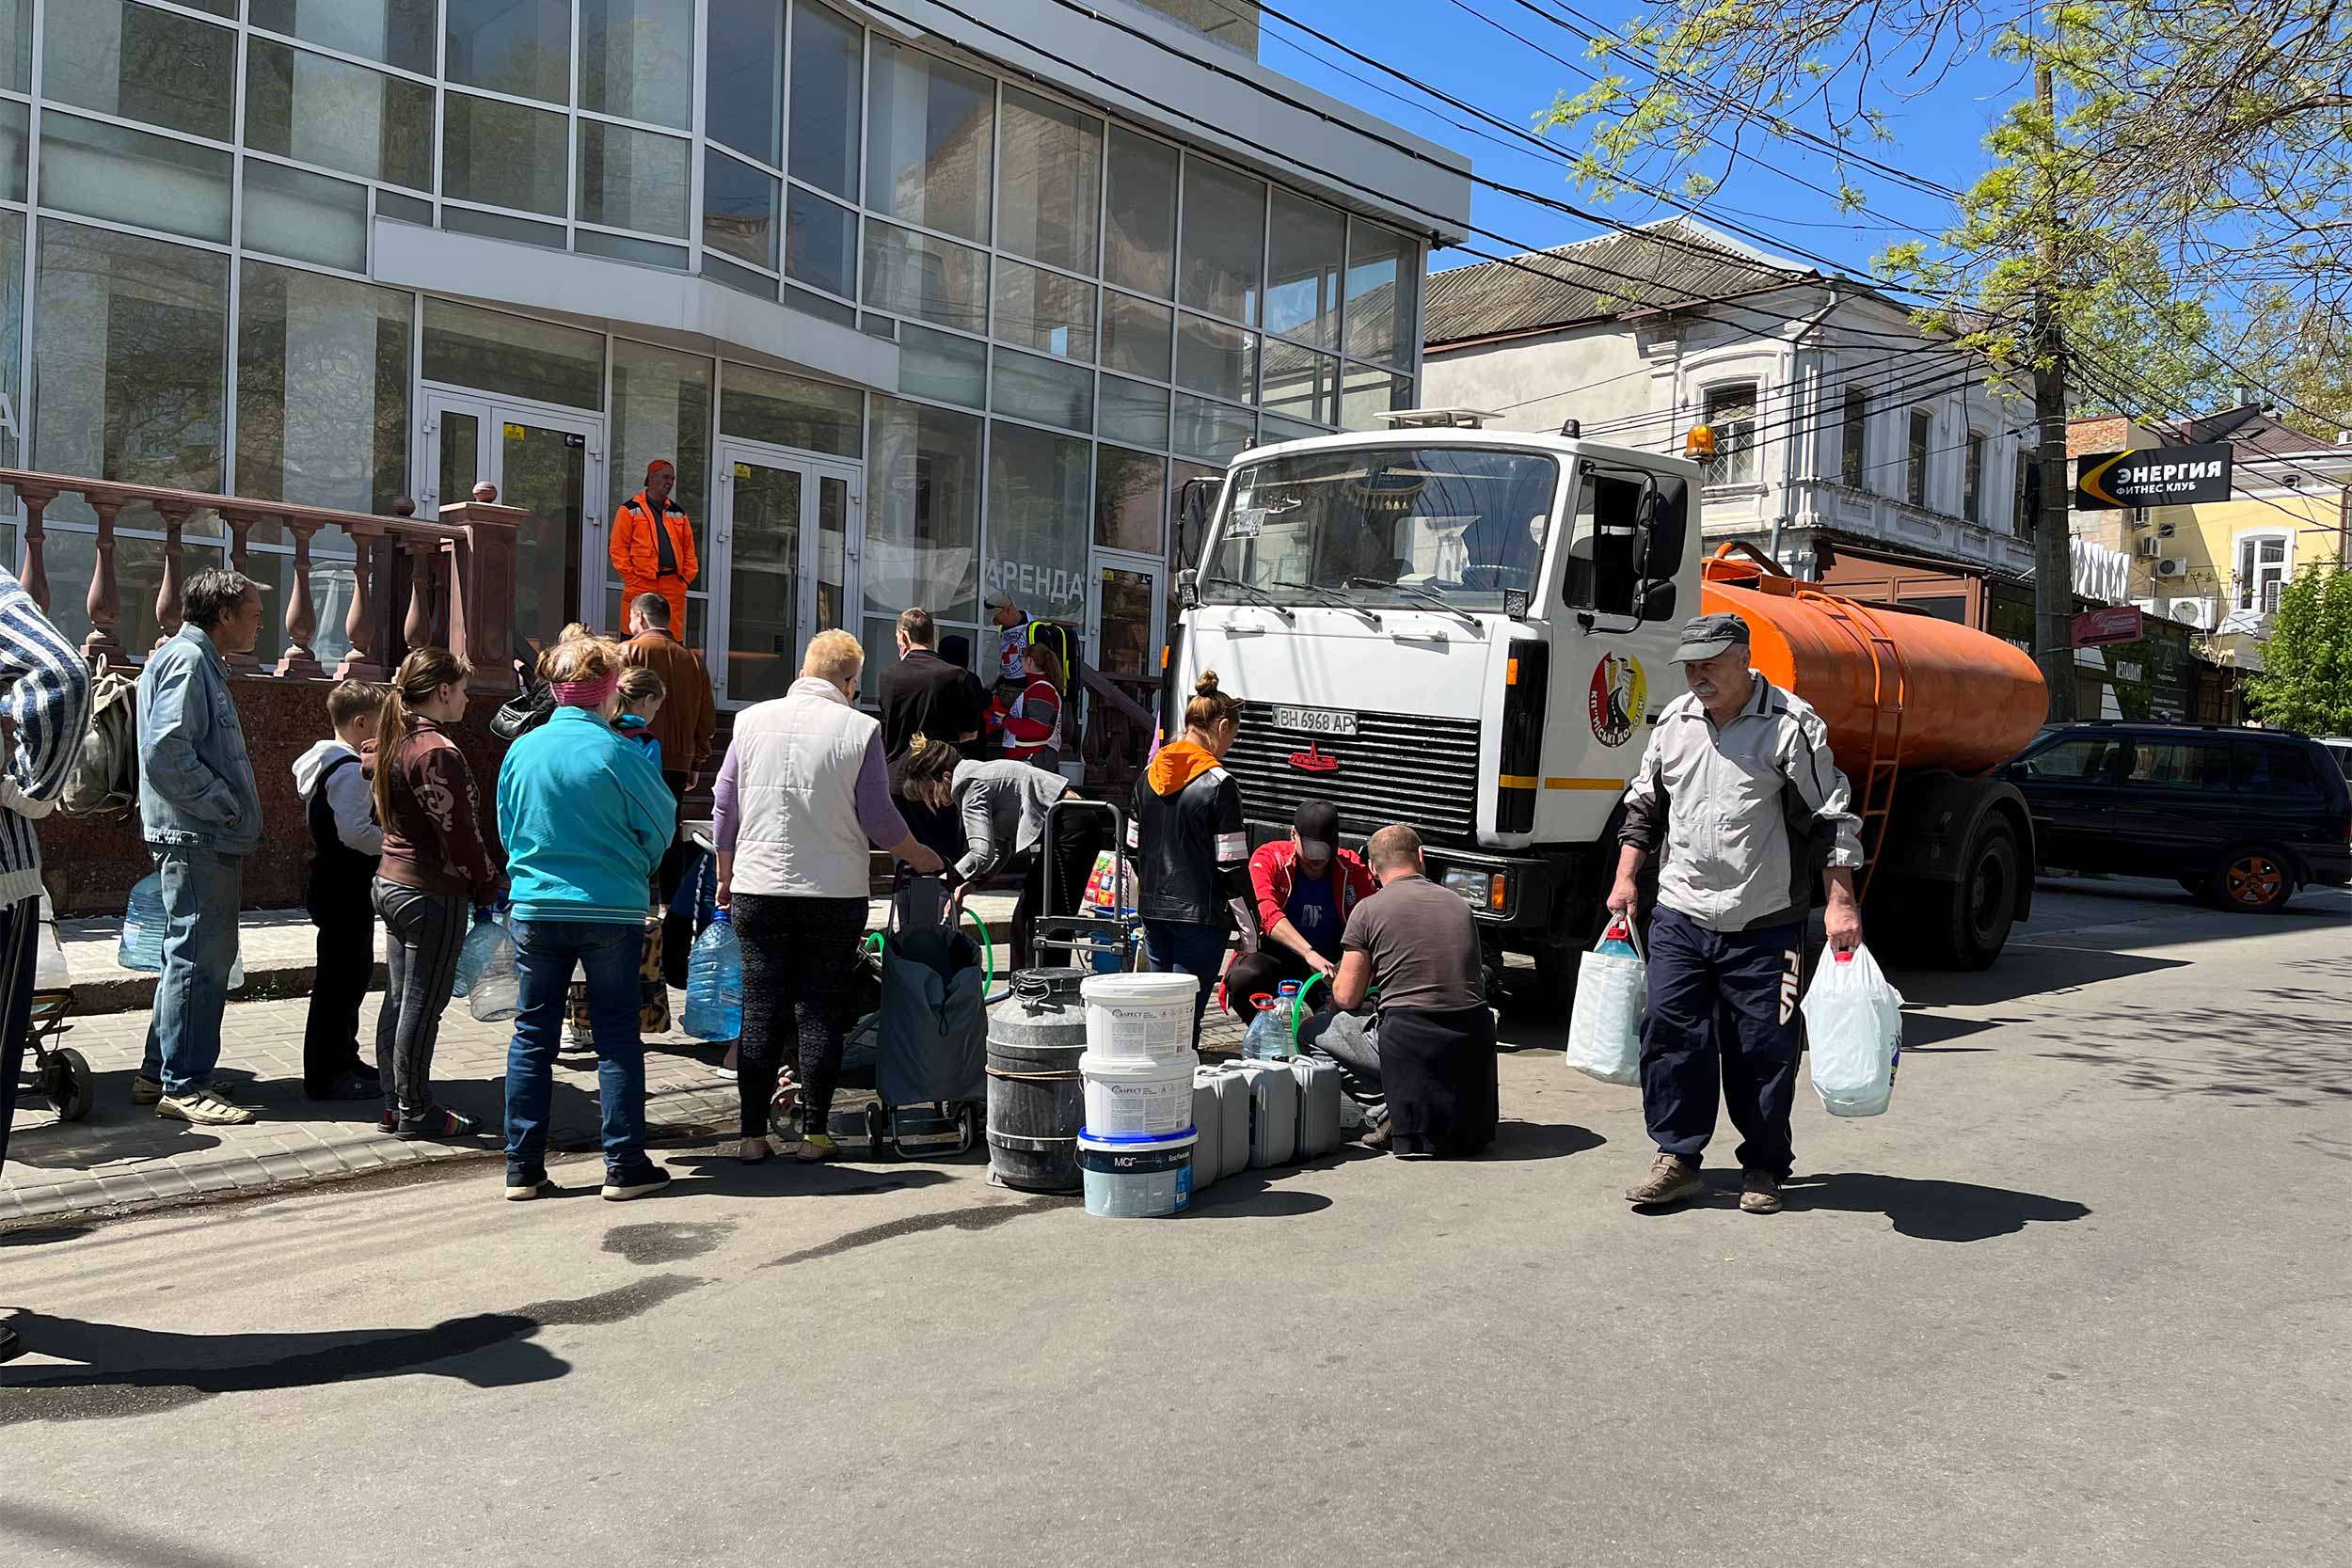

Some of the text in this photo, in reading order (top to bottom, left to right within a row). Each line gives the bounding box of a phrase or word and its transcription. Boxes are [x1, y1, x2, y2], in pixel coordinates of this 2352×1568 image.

[2116, 460, 2222, 484] ЭНЕРГИЯ
[2116, 481, 2196, 496] ФИТНЕС КЛУБ
[986, 557, 1084, 605] АРЕНДА
[1280, 709, 1353, 733] BH 6968 AP
